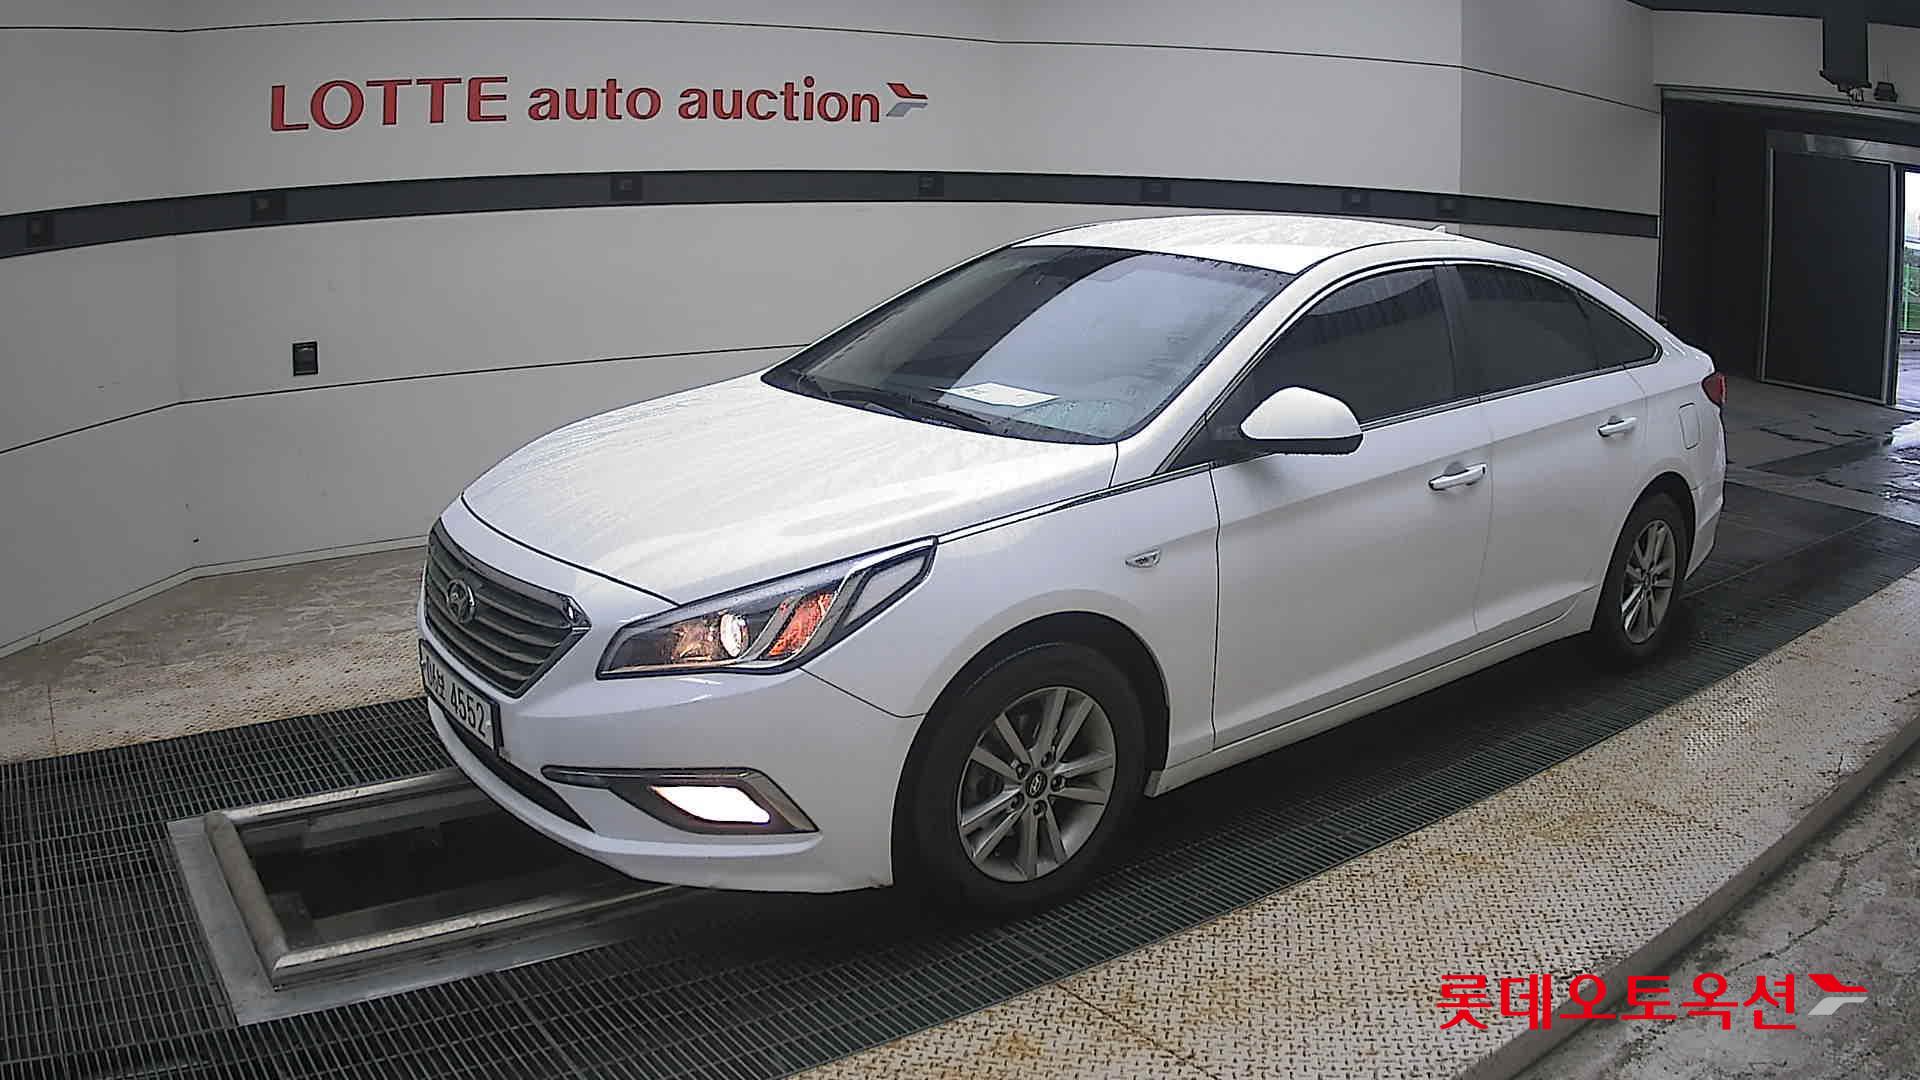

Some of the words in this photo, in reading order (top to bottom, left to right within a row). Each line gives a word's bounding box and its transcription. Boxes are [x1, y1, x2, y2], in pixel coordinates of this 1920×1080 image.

[270, 76, 507, 131] LOTTE
[527, 79, 662, 121] auto
[678, 76, 881, 122] auction
[450, 682, 486, 738] 4552
